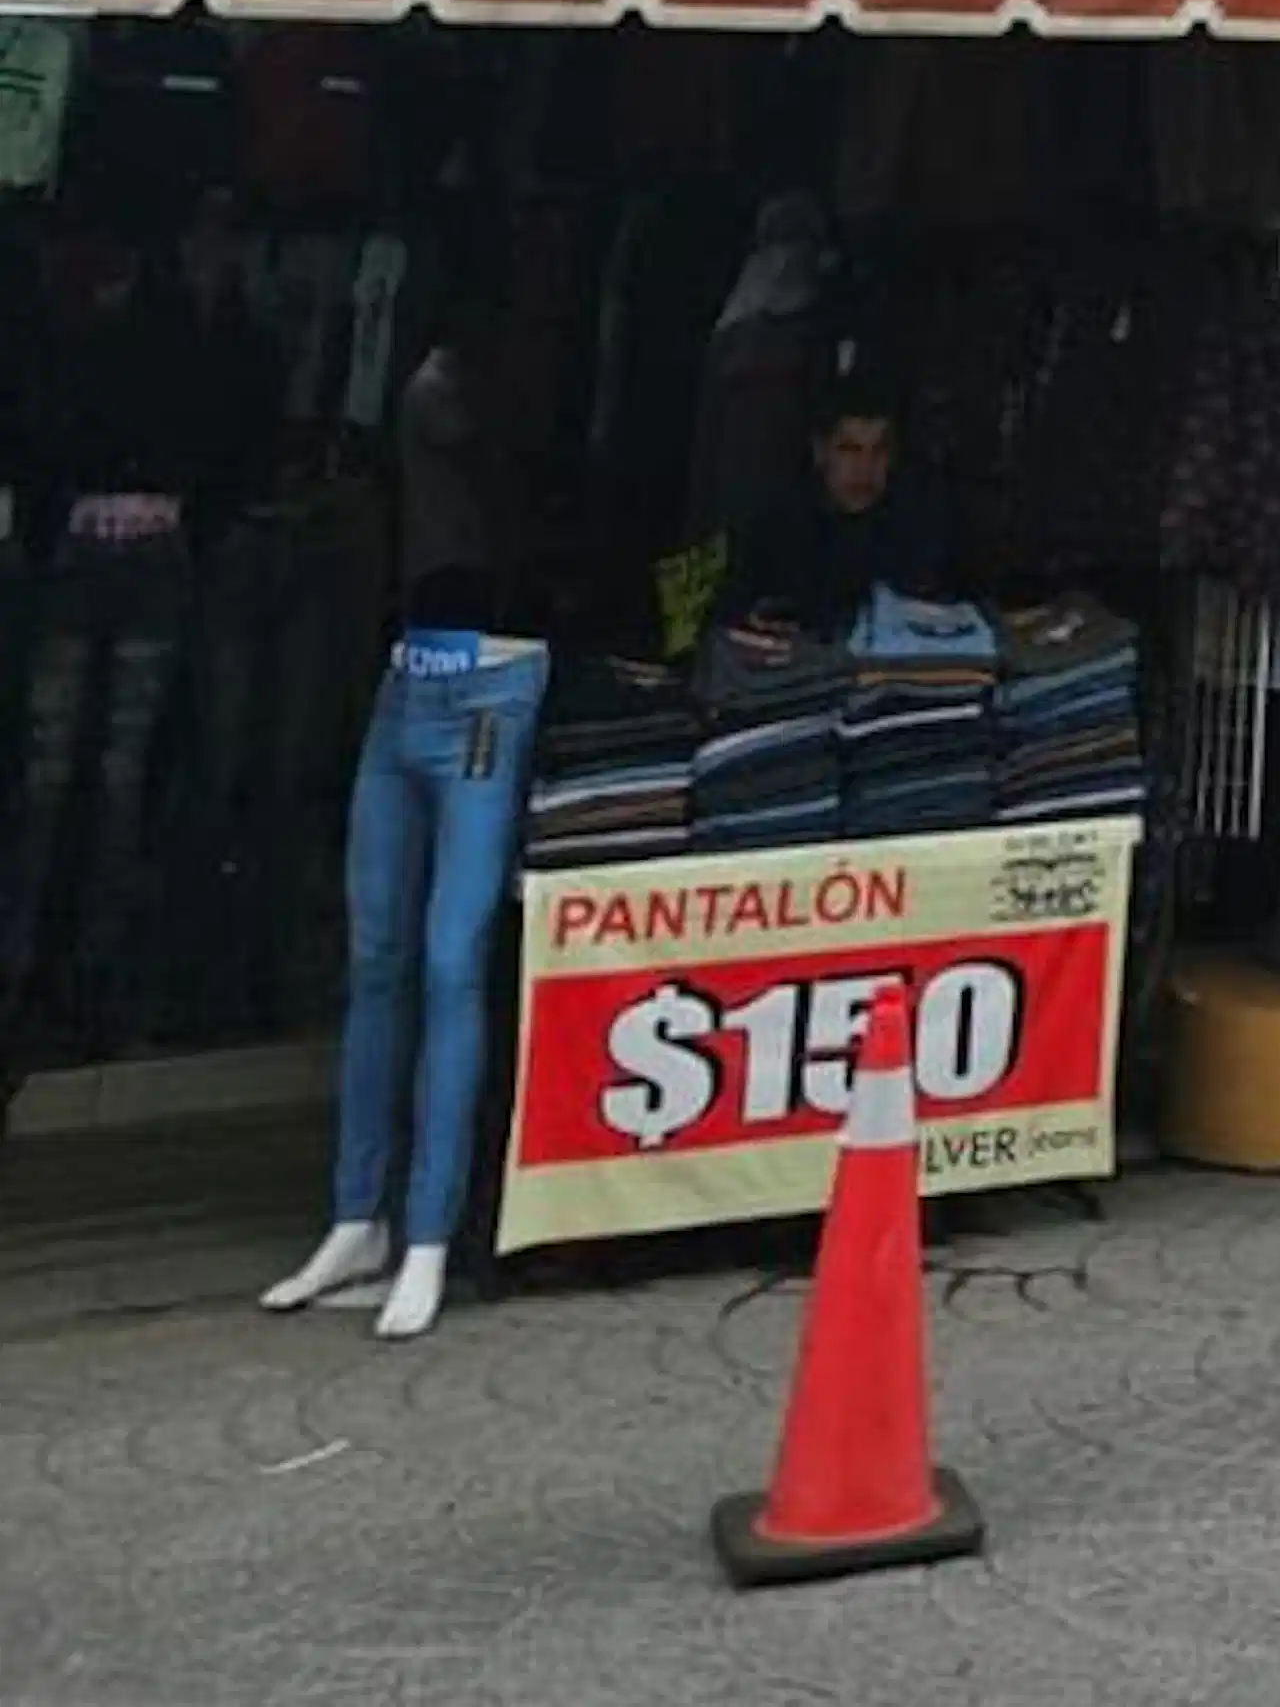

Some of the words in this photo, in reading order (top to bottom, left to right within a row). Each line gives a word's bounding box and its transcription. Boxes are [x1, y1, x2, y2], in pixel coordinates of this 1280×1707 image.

[553, 860, 906, 948] PANTALÓN
[602, 960, 1020, 1149] $150
[925, 1127, 1018, 1173] LVER
